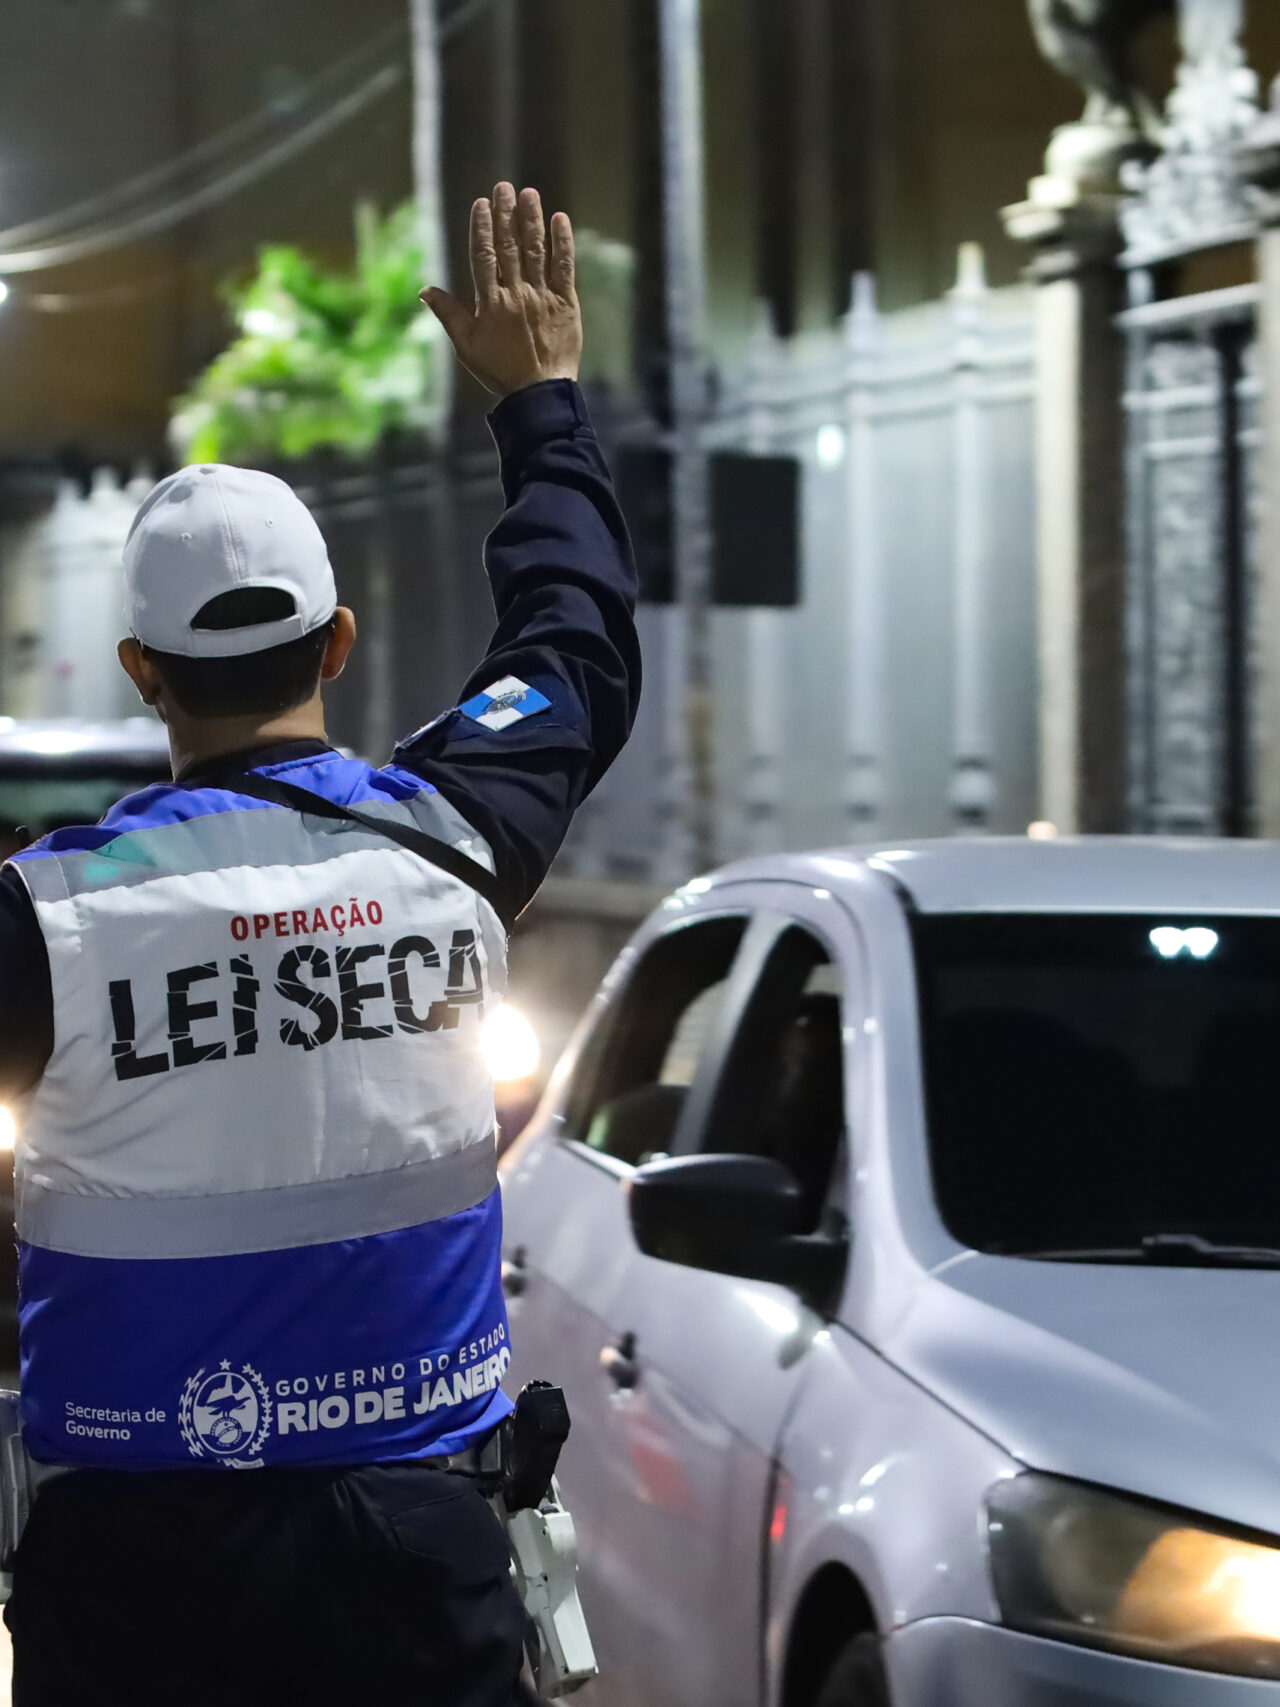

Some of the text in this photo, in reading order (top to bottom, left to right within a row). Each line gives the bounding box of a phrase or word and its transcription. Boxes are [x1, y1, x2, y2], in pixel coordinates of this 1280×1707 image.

[230, 897, 384, 941] OPERAÇÃO
[109, 929, 485, 1081] LEI SECA
[275, 1322, 506, 1397] GOVERNO DO ESTADO
[65, 1401, 166, 1423] Secretaria de
[276, 1395, 350, 1435] RIO
[354, 1386, 407, 1425] DE
[413, 1346, 512, 1415] JANEIRO
[65, 1420, 131, 1441] Governo
